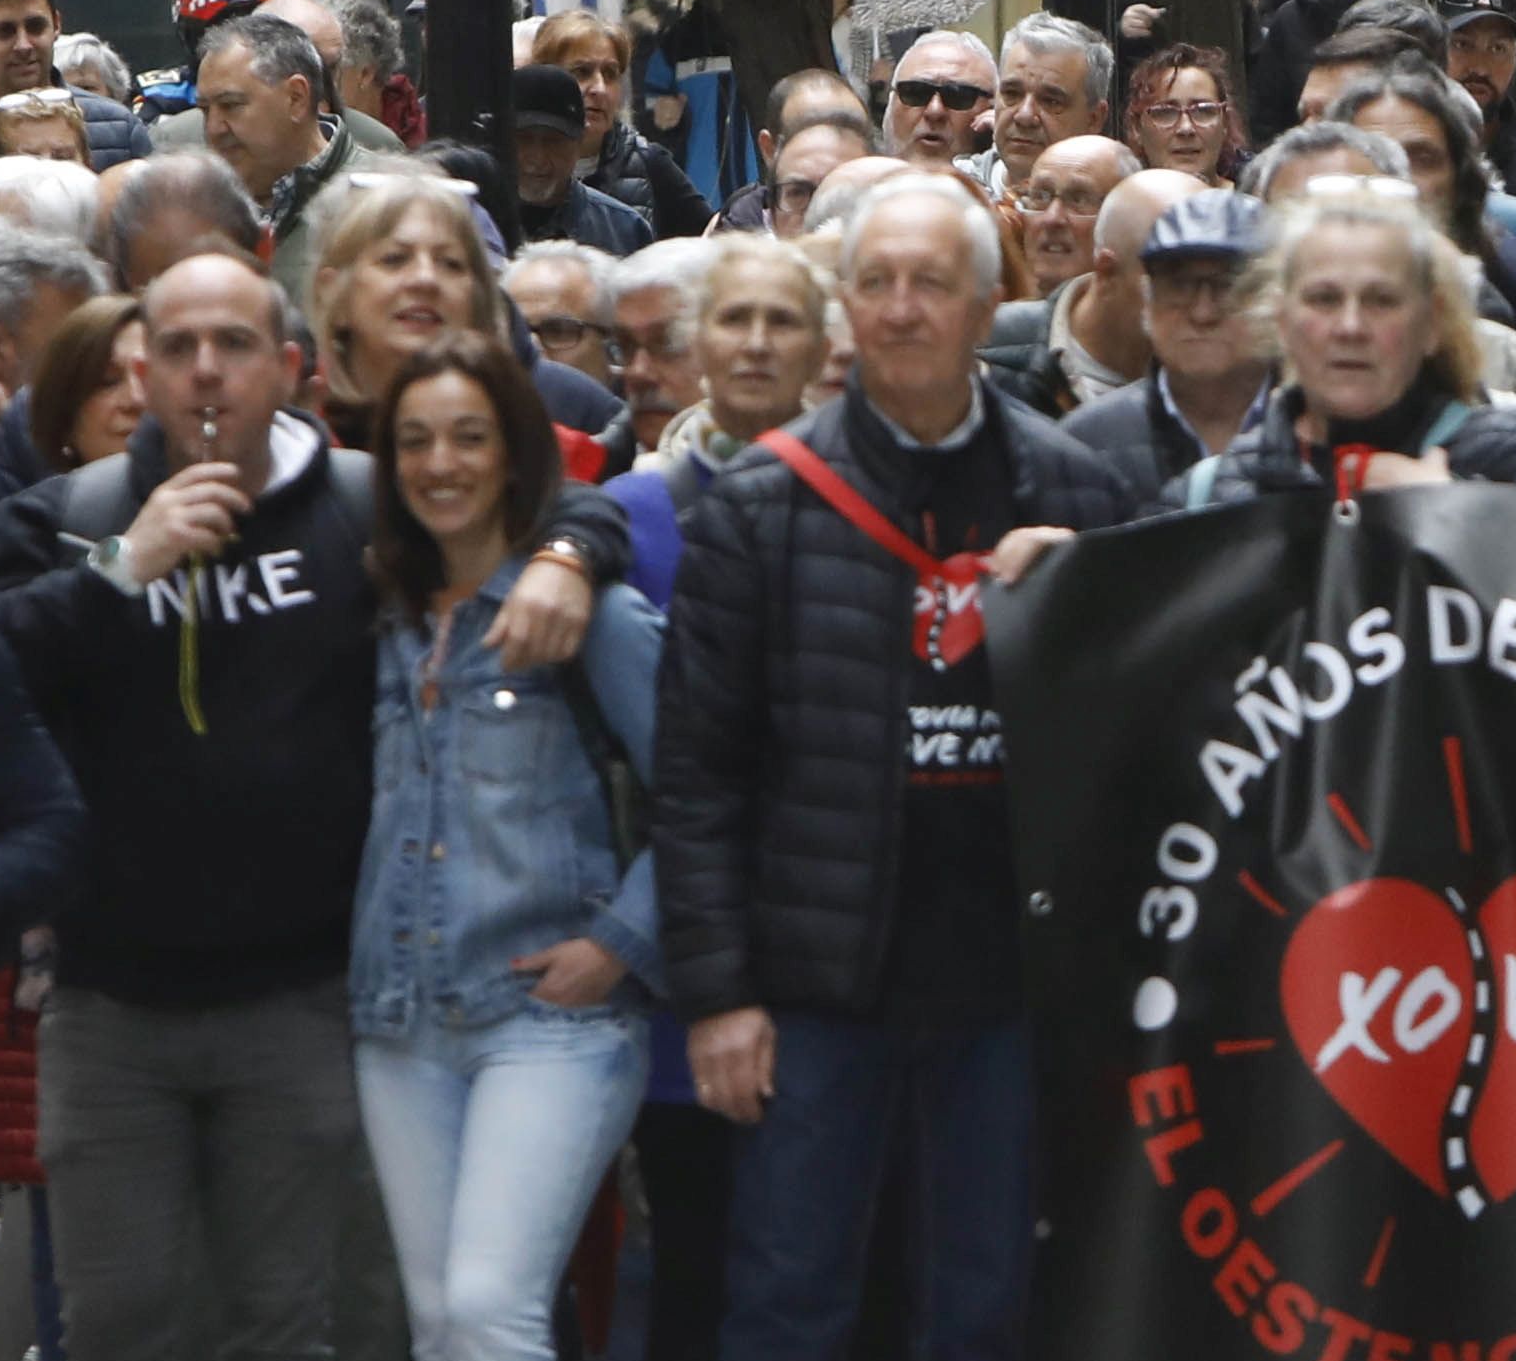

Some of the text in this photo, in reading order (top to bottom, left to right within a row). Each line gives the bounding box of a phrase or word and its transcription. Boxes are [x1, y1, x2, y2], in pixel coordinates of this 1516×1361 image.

[146, 549, 317, 626] NIKE
[1139, 822, 1219, 941] 30
[1197, 606, 1406, 818] AÑOS
[1128, 1063, 1204, 1187] EL
